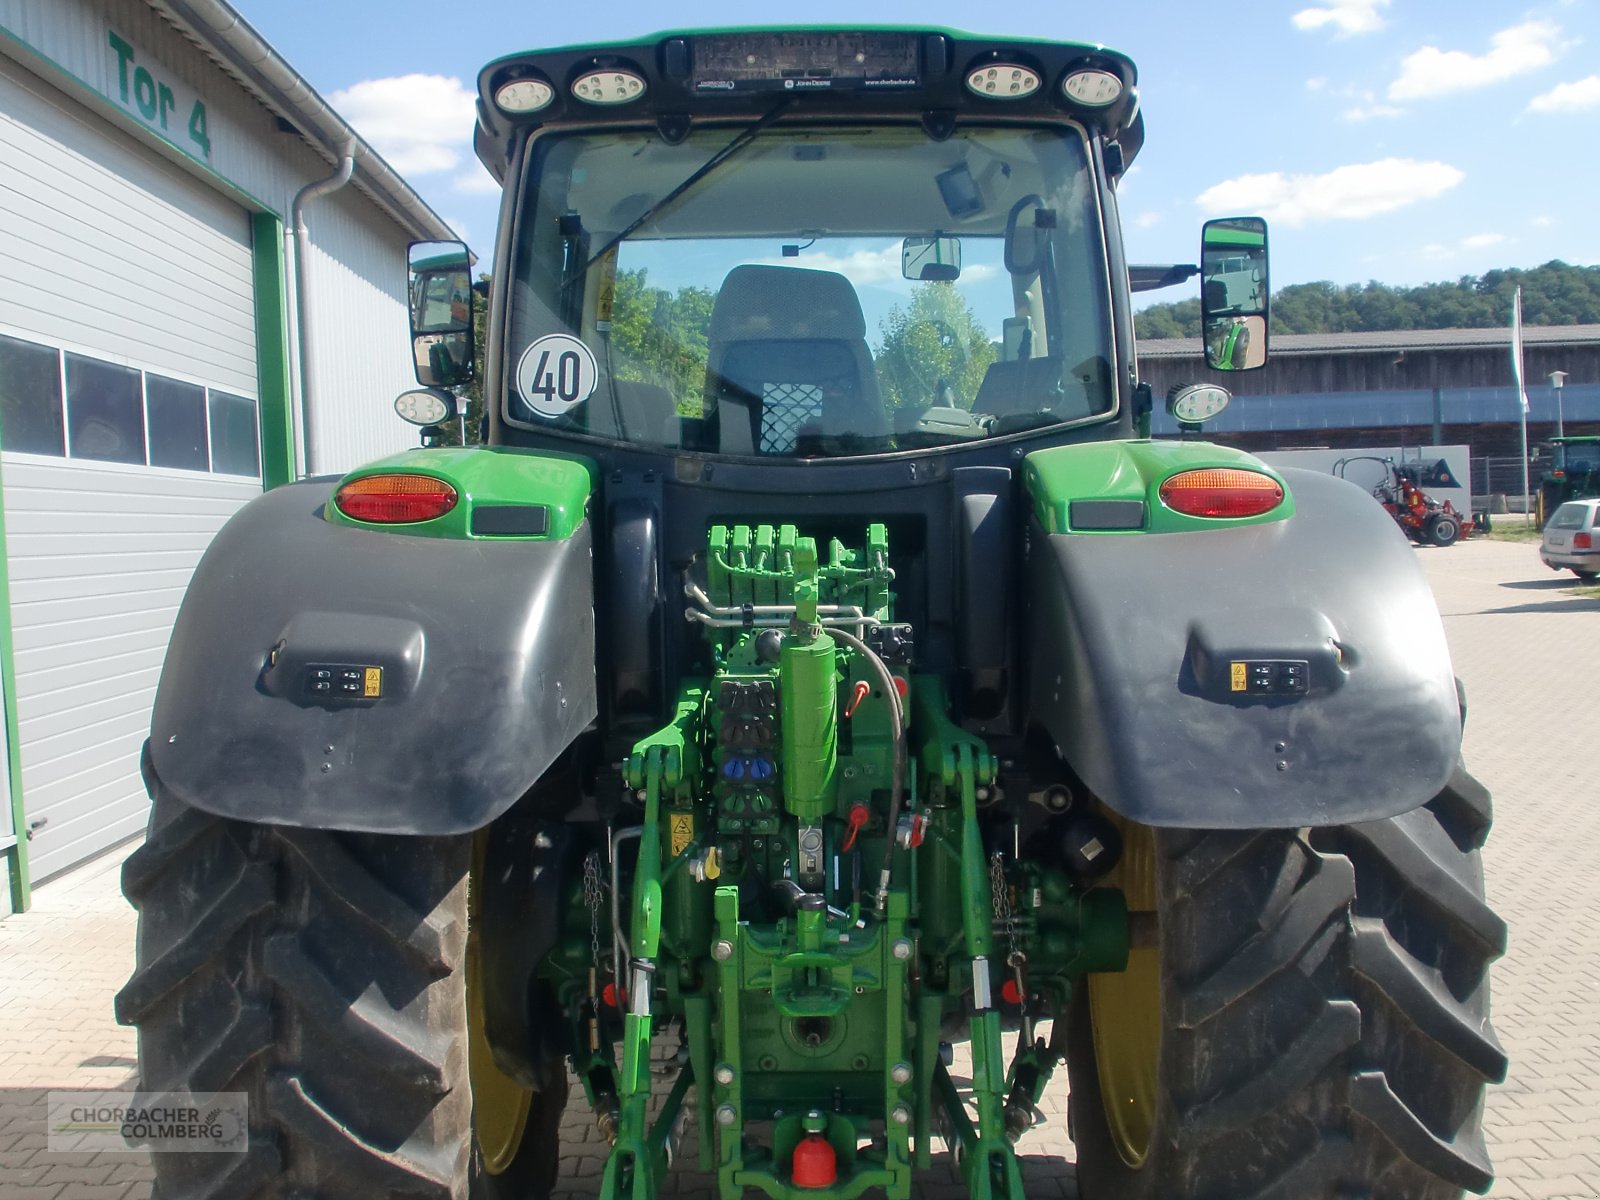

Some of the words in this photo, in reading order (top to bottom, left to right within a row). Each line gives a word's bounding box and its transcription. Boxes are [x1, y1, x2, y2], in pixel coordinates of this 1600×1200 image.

[108, 30, 175, 131] Tor
[188, 99, 211, 158] 4
[531, 350, 581, 402] 40
